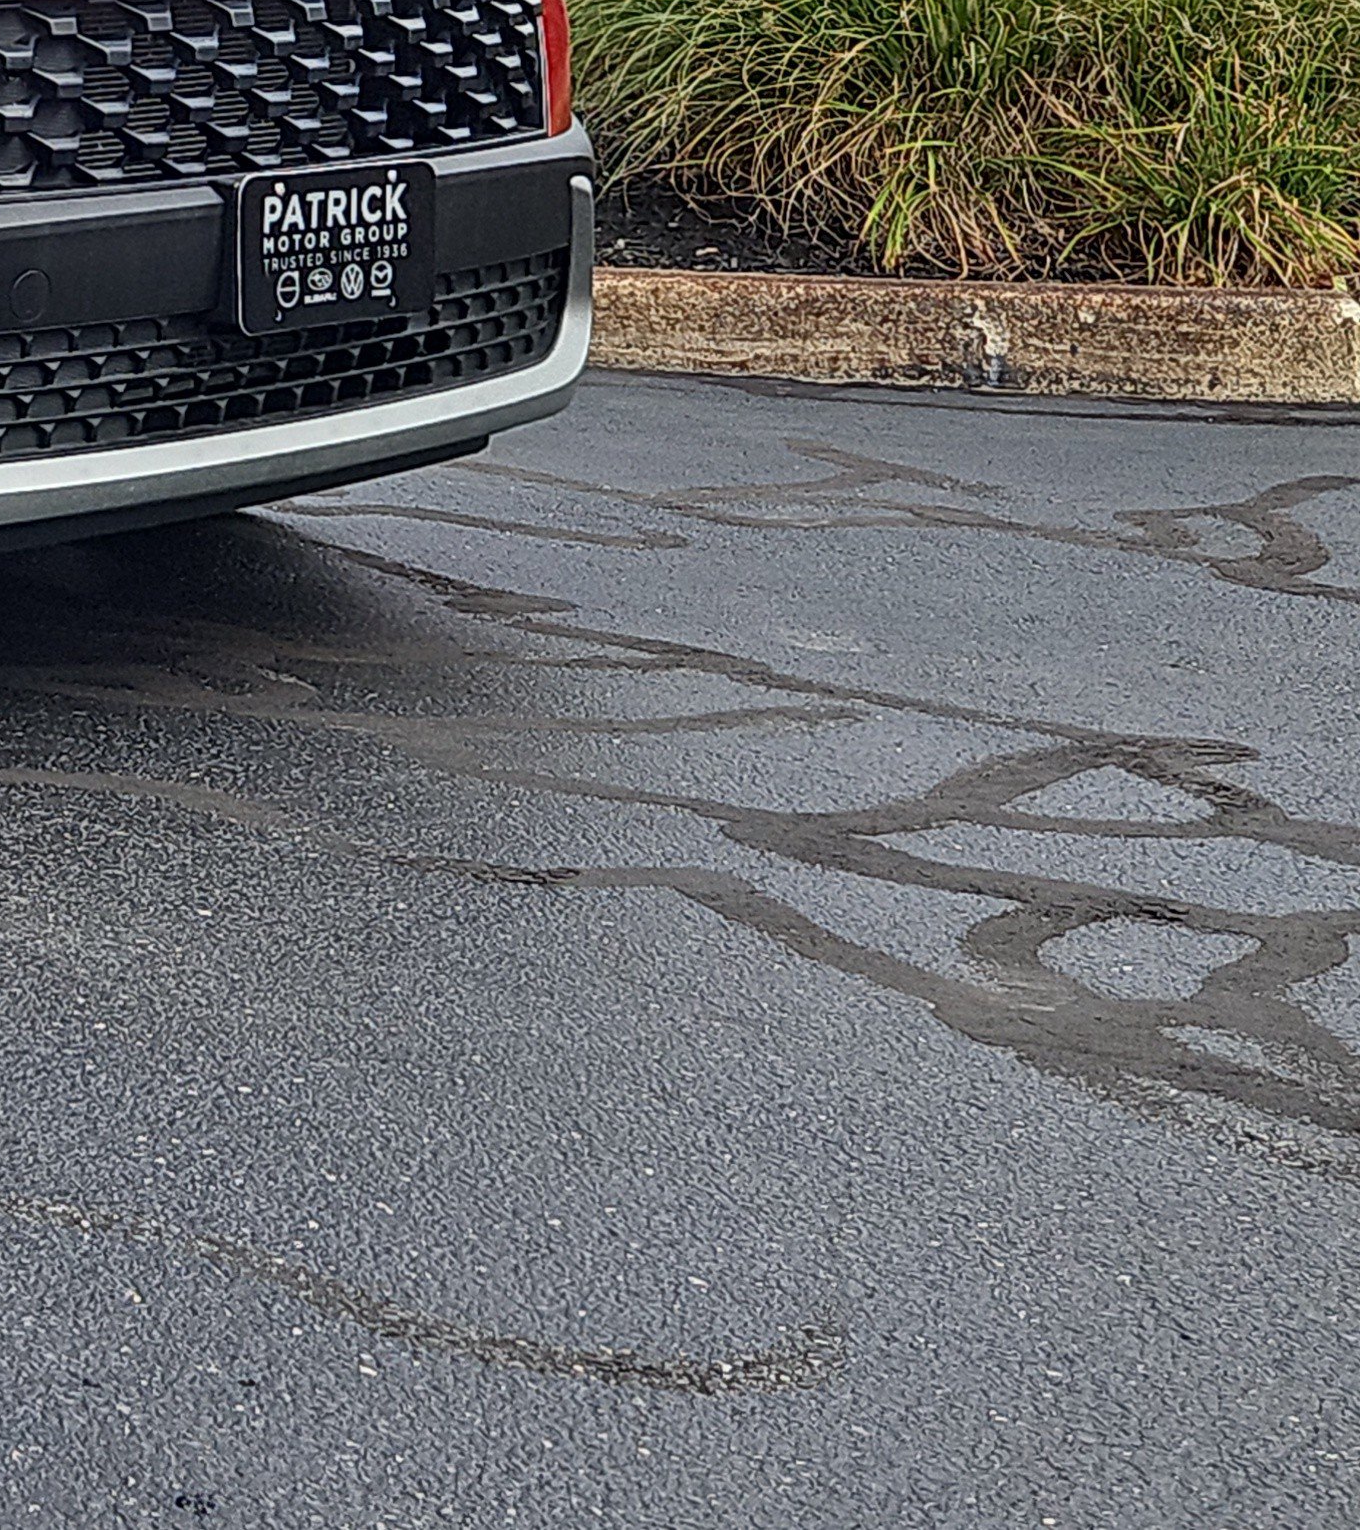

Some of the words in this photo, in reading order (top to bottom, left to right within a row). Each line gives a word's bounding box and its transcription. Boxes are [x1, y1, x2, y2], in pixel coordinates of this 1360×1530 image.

[263, 182, 408, 235] PATRICK
[263, 230, 331, 255] MOTOR
[340, 222, 408, 246] GROUP
[263, 253, 324, 271] TRUSTED
[330, 247, 371, 265] SINCE
[376, 243, 408, 259] 1936
